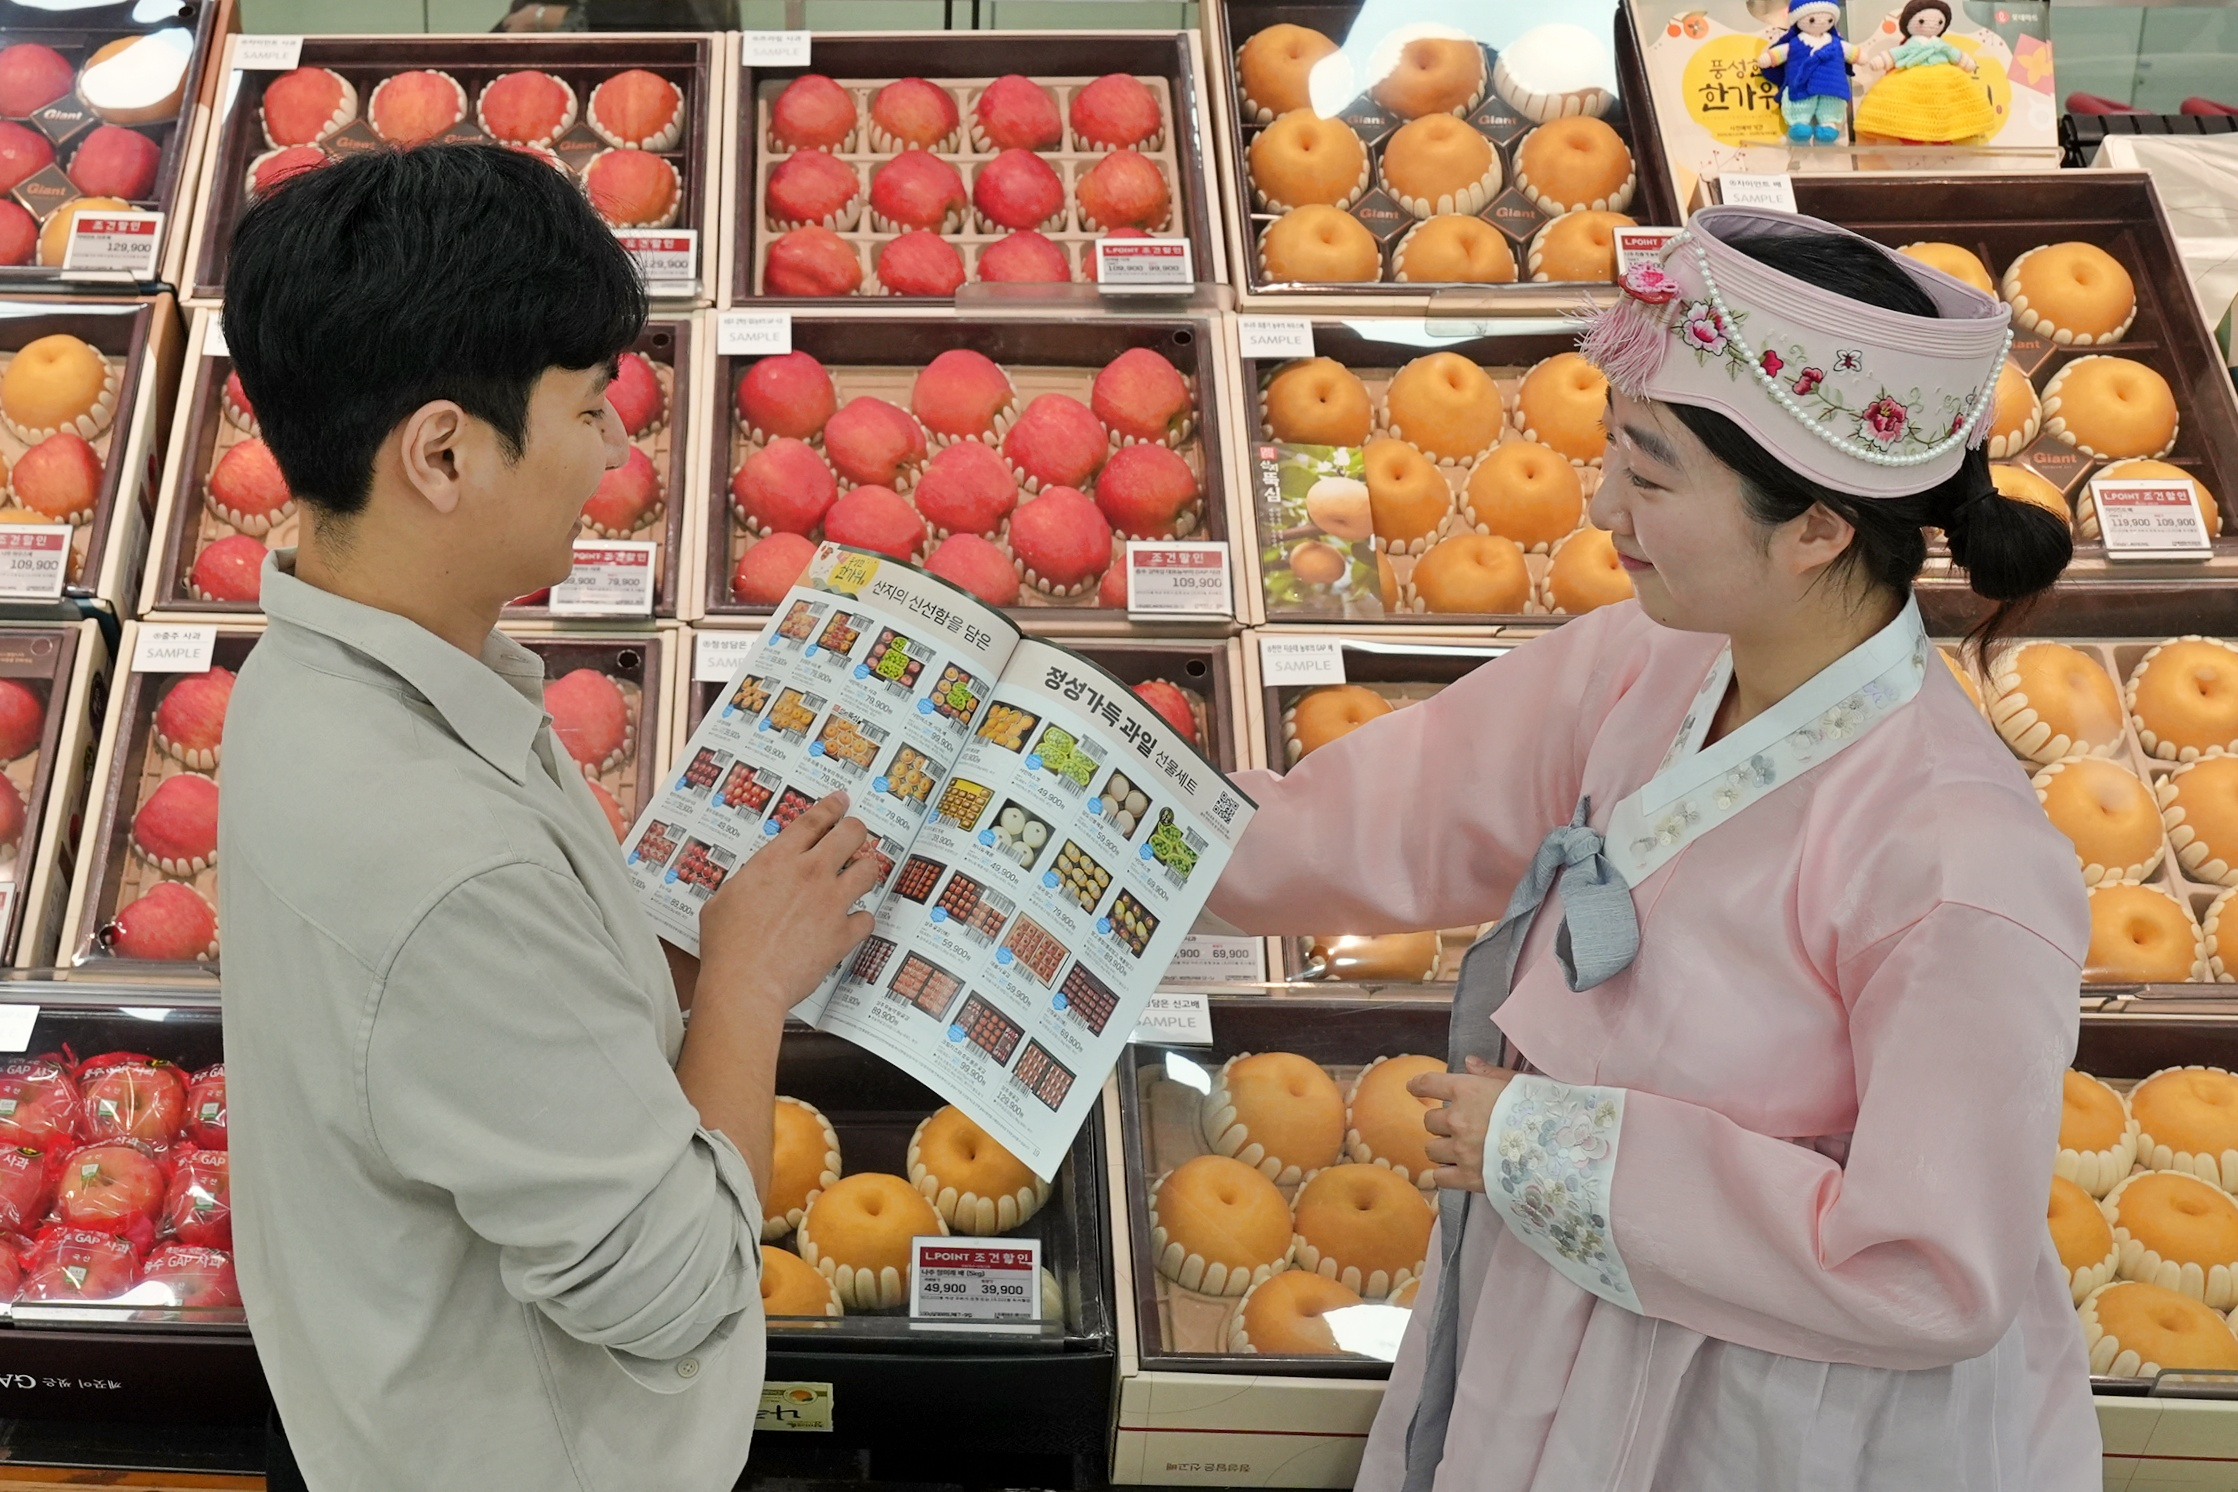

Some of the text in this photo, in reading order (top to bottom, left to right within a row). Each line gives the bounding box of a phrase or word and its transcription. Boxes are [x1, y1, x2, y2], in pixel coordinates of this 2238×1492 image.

[243, 51, 288, 60] SAMPLE
[753, 47, 800, 56] SAMPLE
[43, 108, 83, 120] Giant
[1348, 113, 1386, 125] Giant
[1478, 113, 1517, 126] Giant
[336, 136, 376, 150] Giant
[560, 140, 599, 151] Giant
[26, 182, 67, 196] Giant
[1733, 193, 1784, 204] SAMPLE
[1359, 206, 1400, 220] Giant
[1495, 207, 1536, 220] Giant
[107, 242, 152, 254] 129,900
[1624, 238, 1658, 246] L.POINT
[729, 332, 780, 342] SAMPLE
[1250, 335, 1302, 345] SAMPLE
[2012, 340, 2041, 349] iant
[2033, 452, 2077, 464] Giant
[2104, 491, 2188, 501] L.POINT 조건할인
[2112, 518, 2196, 528] 119,900 109,900
[1151, 552, 1205, 564] 조건할인
[10, 559, 59, 571] 109,900
[607, 578, 640, 586] 79,900
[1172, 577, 1222, 589] 109,900
[873, 580, 992, 652] 산지의 신선함을 담은
[182, 632, 201, 640] 사과
[147, 648, 201, 659] SAMPLE
[1275, 660, 1332, 672] SAMPLE
[865, 694, 893, 715] 79,900원
[1044, 666, 1198, 796] 정성가득 과일 선물세트
[931, 731, 954, 753] 99,900원
[763, 744, 787, 761] 49,900원
[820, 772, 849, 792] 79,900원
[1037, 786, 1066, 810] 49,900원
[884, 809, 911, 831] 79,900원
[717, 821, 741, 839] 49,900원
[1096, 831, 1120, 856] 59,900원
[990, 861, 1019, 885] 49,900원
[1146, 877, 1170, 901] 69,900원
[669, 898, 695, 917] 89,900원
[1052, 905, 1077, 931] 79,900원
[940, 939, 972, 961] 59,900원
[1212, 949, 1249, 959] 69,900
[1103, 952, 1128, 977] 89,900원
[1005, 982, 1032, 1008] 59,900원
[1172, 1000, 1200, 1009] 신고배
[871, 1005, 900, 1025] 89,900원
[1060, 1028, 1084, 1052] 69,900원
[6, 1064, 31, 1075] GAP
[209, 1067, 225, 1078] GA
[959, 1061, 987, 1087] 99,900원
[996, 1091, 1025, 1119] 129,900원
[114, 1136, 138, 1146] 사과
[1032, 1148, 1041, 1158] 19
[3, 1153, 30, 1170] 사과
[200, 1154, 226, 1166] GAP
[74, 1233, 101, 1245] GAP
[103, 1241, 129, 1254] 사과
[168, 1256, 192, 1268] GAP
[925, 1252, 1029, 1265] L.POINT 조건할인
[966, 1270, 985, 1278] (5kg)
[924, 1283, 1024, 1295] 49,900 39,900
[0, 1373, 122, 1390] 깨끗이 씻은 GA
[1166, 1462, 1251, 1473] 정성담은 신고배
